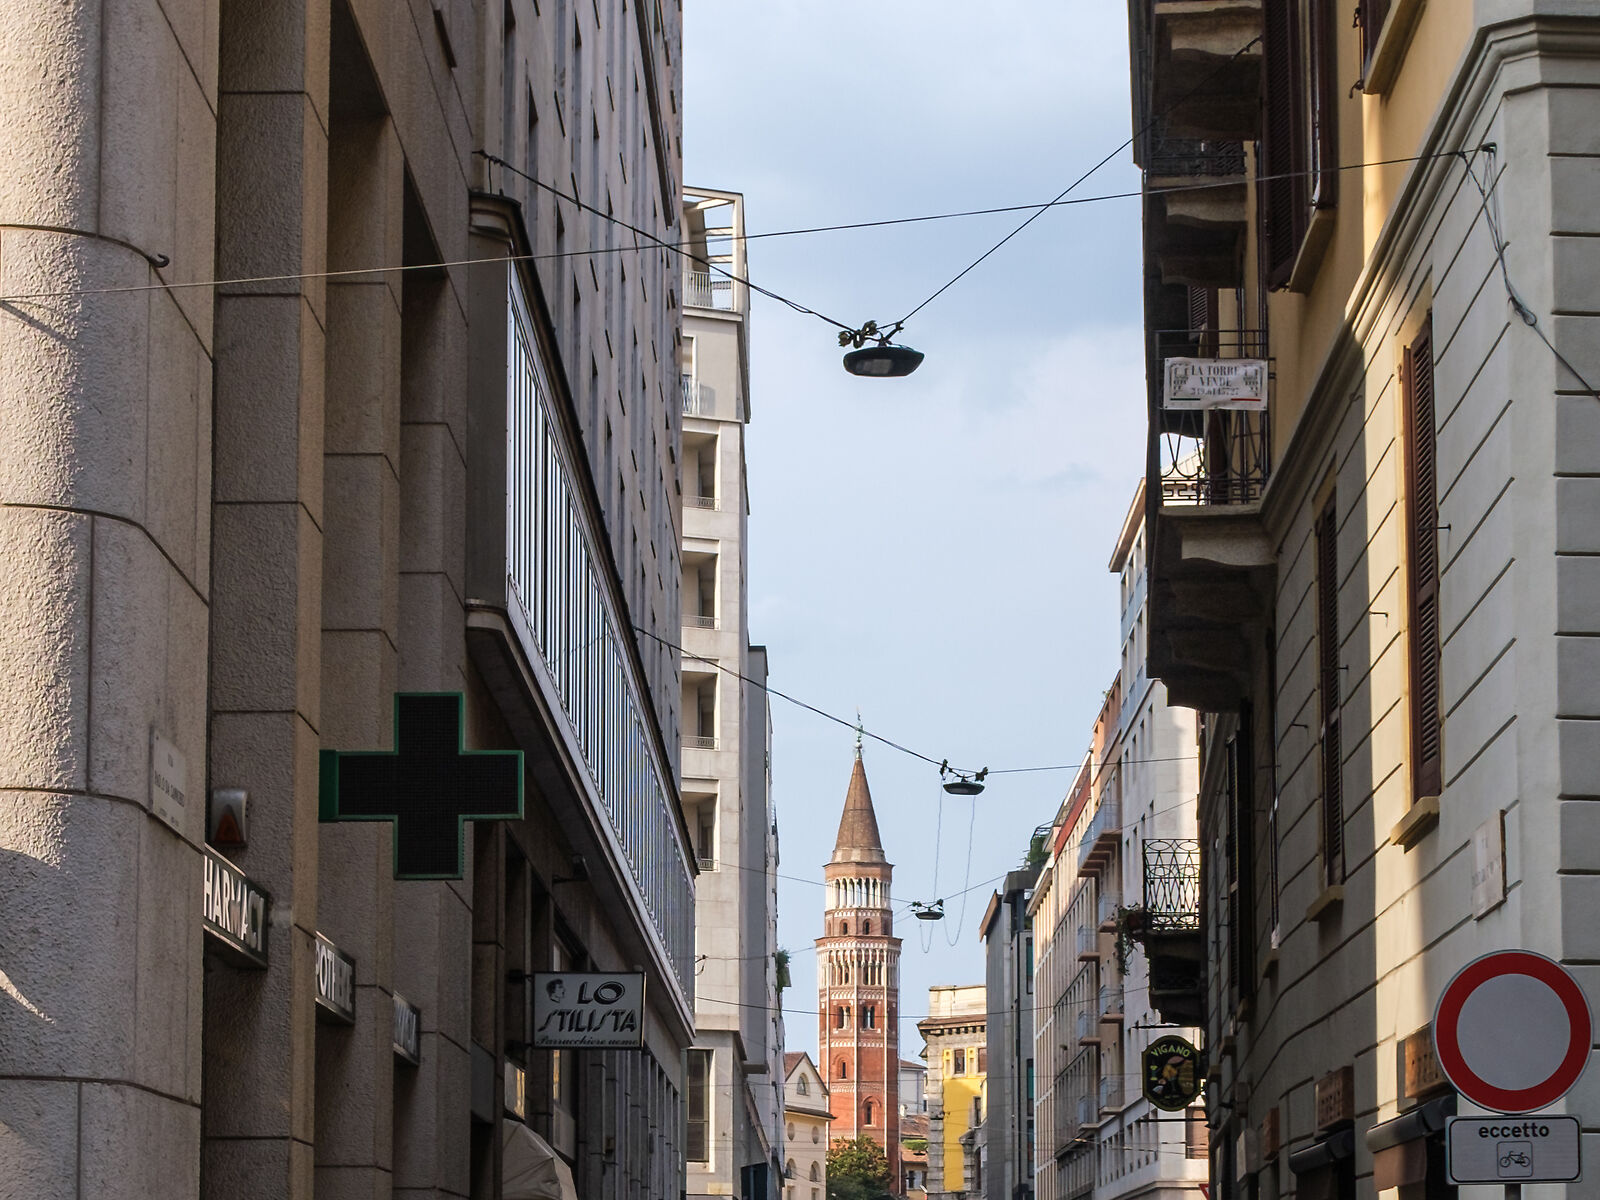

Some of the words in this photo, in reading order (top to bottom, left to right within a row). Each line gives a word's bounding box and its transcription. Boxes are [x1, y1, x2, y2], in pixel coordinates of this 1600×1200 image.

[1191, 365, 1204, 376] LA
[1207, 365, 1239, 376] TORRE
[1199, 376, 1232, 387] VENDE
[577, 981, 626, 1005] LO
[537, 1009, 637, 1032] STILISTA
[1478, 1122, 1550, 1138] eccetto
